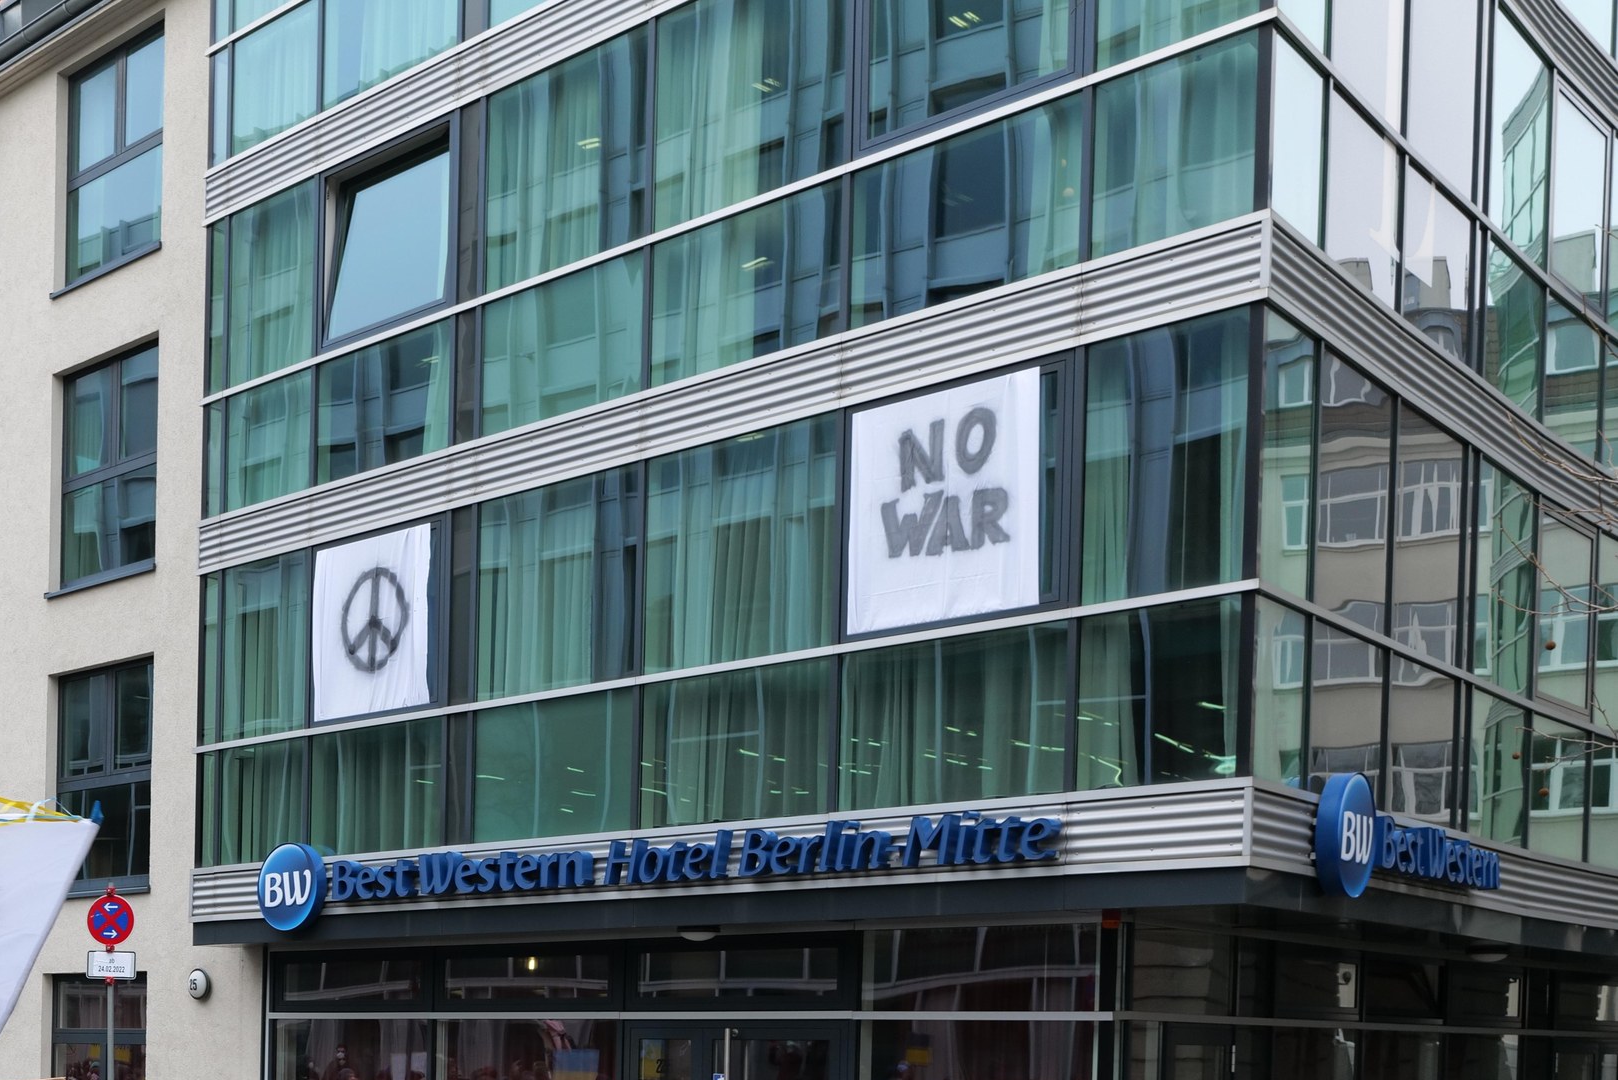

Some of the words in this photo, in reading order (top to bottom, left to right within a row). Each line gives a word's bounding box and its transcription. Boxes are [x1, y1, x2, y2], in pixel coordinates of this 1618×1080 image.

[899, 407, 996, 492] NO
[881, 487, 1010, 558] WAR
[331, 860, 418, 900] Best
[418, 851, 593, 896] Western
[605, 829, 734, 885] Hotel
[739, 811, 1062, 877] Berlin-Mitte
[1341, 811, 1373, 865] BW
[1379, 816, 1426, 876] Best
[1428, 828, 1500, 889] Western
[264, 869, 312, 908] BW
[98, 965, 126, 974] 24.02.2022
